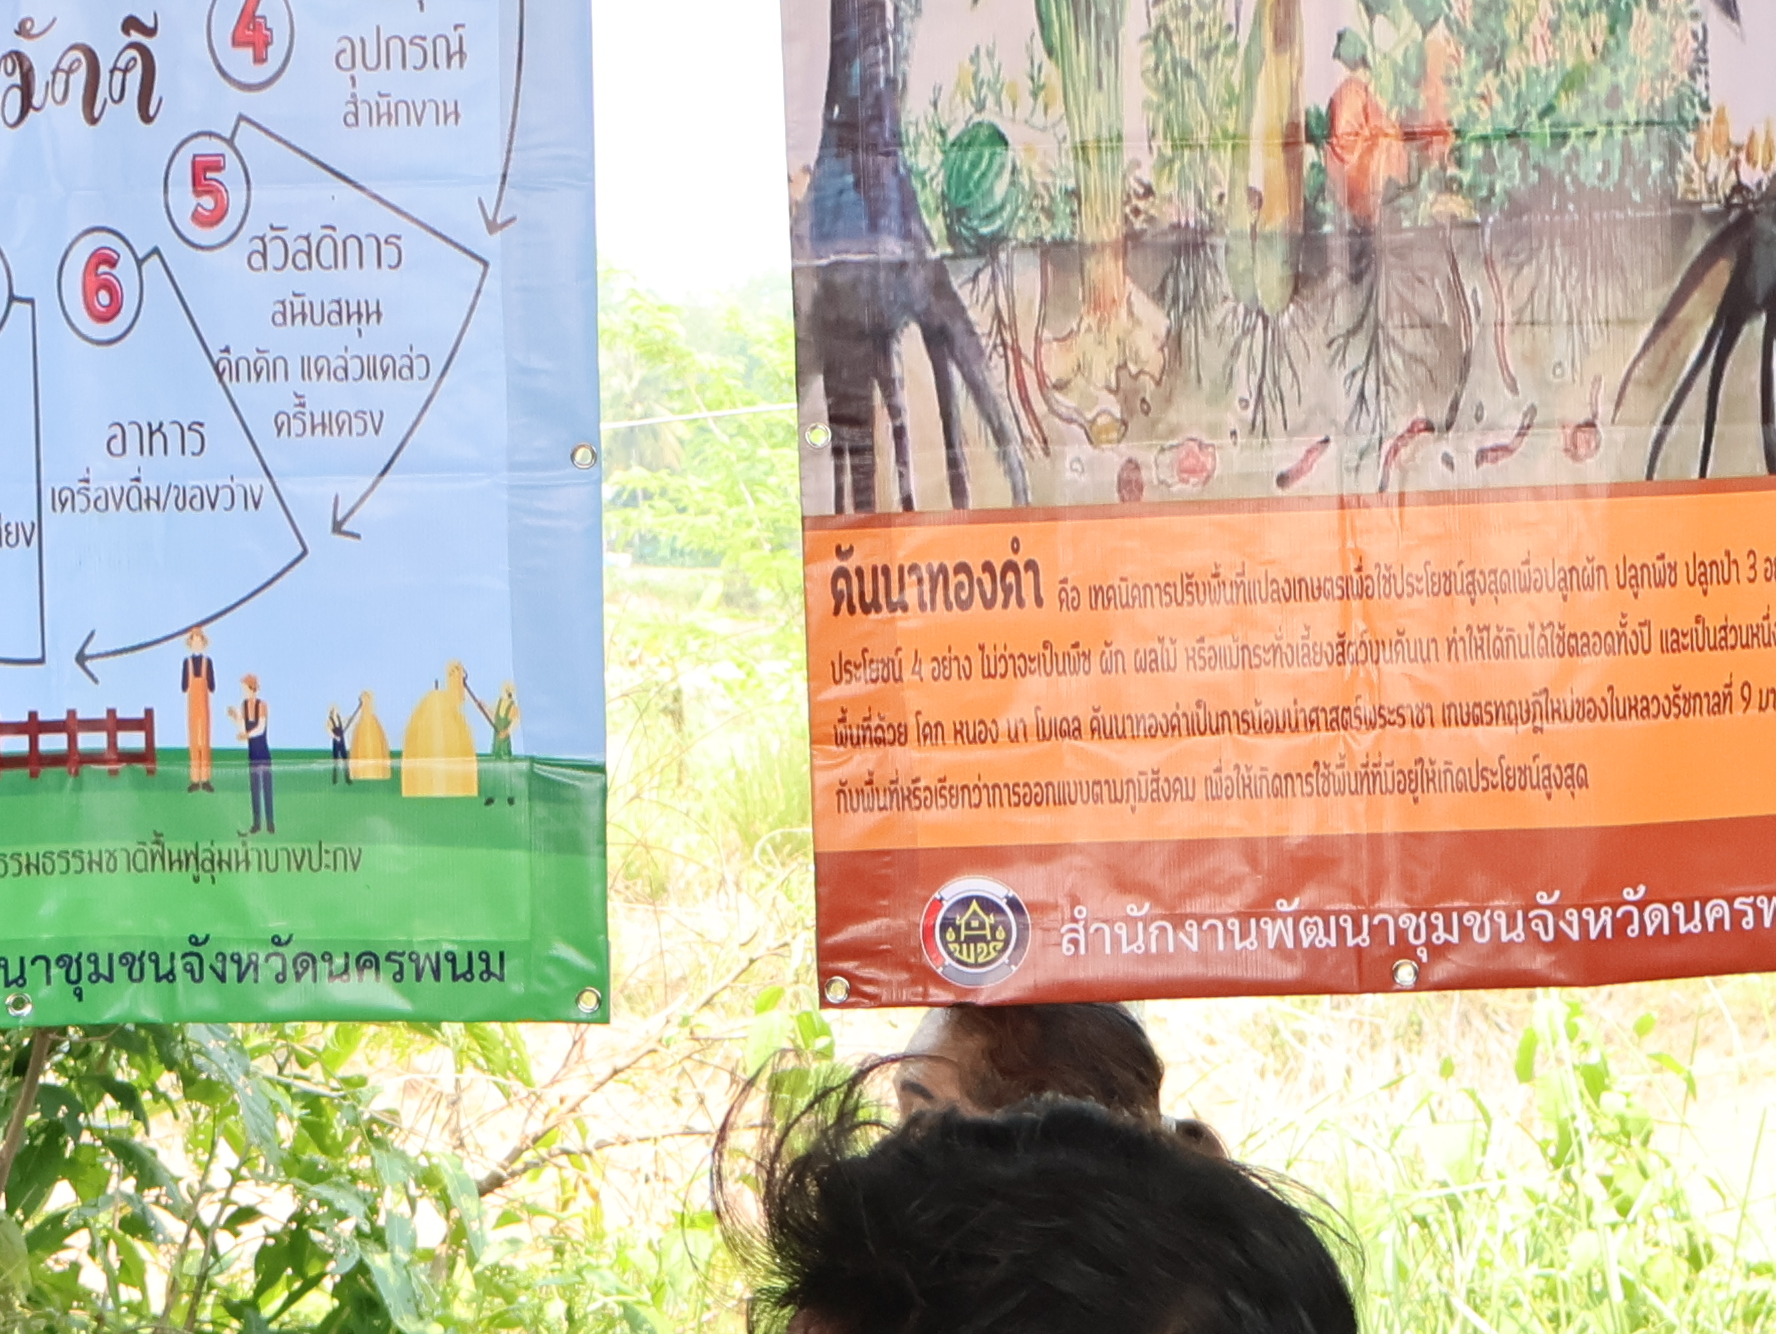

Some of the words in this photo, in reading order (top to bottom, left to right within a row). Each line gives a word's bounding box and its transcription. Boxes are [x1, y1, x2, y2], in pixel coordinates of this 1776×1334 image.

[334, 24, 467, 88] อุปกรณ์
[342, 90, 462, 128] สำนักงาน
[189, 153, 231, 230] 5
[247, 223, 404, 273] สวัสดิการ
[80, 246, 124, 325] 6
[271, 290, 384, 339] สนับสนุน
[105, 419, 207, 459] อาหาร
[50, 466, 265, 514] เครื่องดื่ม/ของว่าง
[1615, 553, 1679, 601] ปลูกพืช
[1684, 547, 1741, 599] ปลูกป่า
[1746, 550, 1758, 582] 3
[831, 646, 906, 687] ประโยชน์
[909, 648, 925, 685] 4
[930, 642, 973, 683] อย่าง
[979, 637, 1093, 681] ไม่ว่าจะเป็นพืช
[1100, 638, 1127, 677] ผัก
[1133, 634, 1178, 675] ผลไม้
[915, 710, 945, 746] โคก
[952, 713, 999, 745] หนอง
[1007, 715, 1028, 743] นา
[1034, 705, 1083, 742] โมเดล
[1740, 680, 1753, 714] 9
